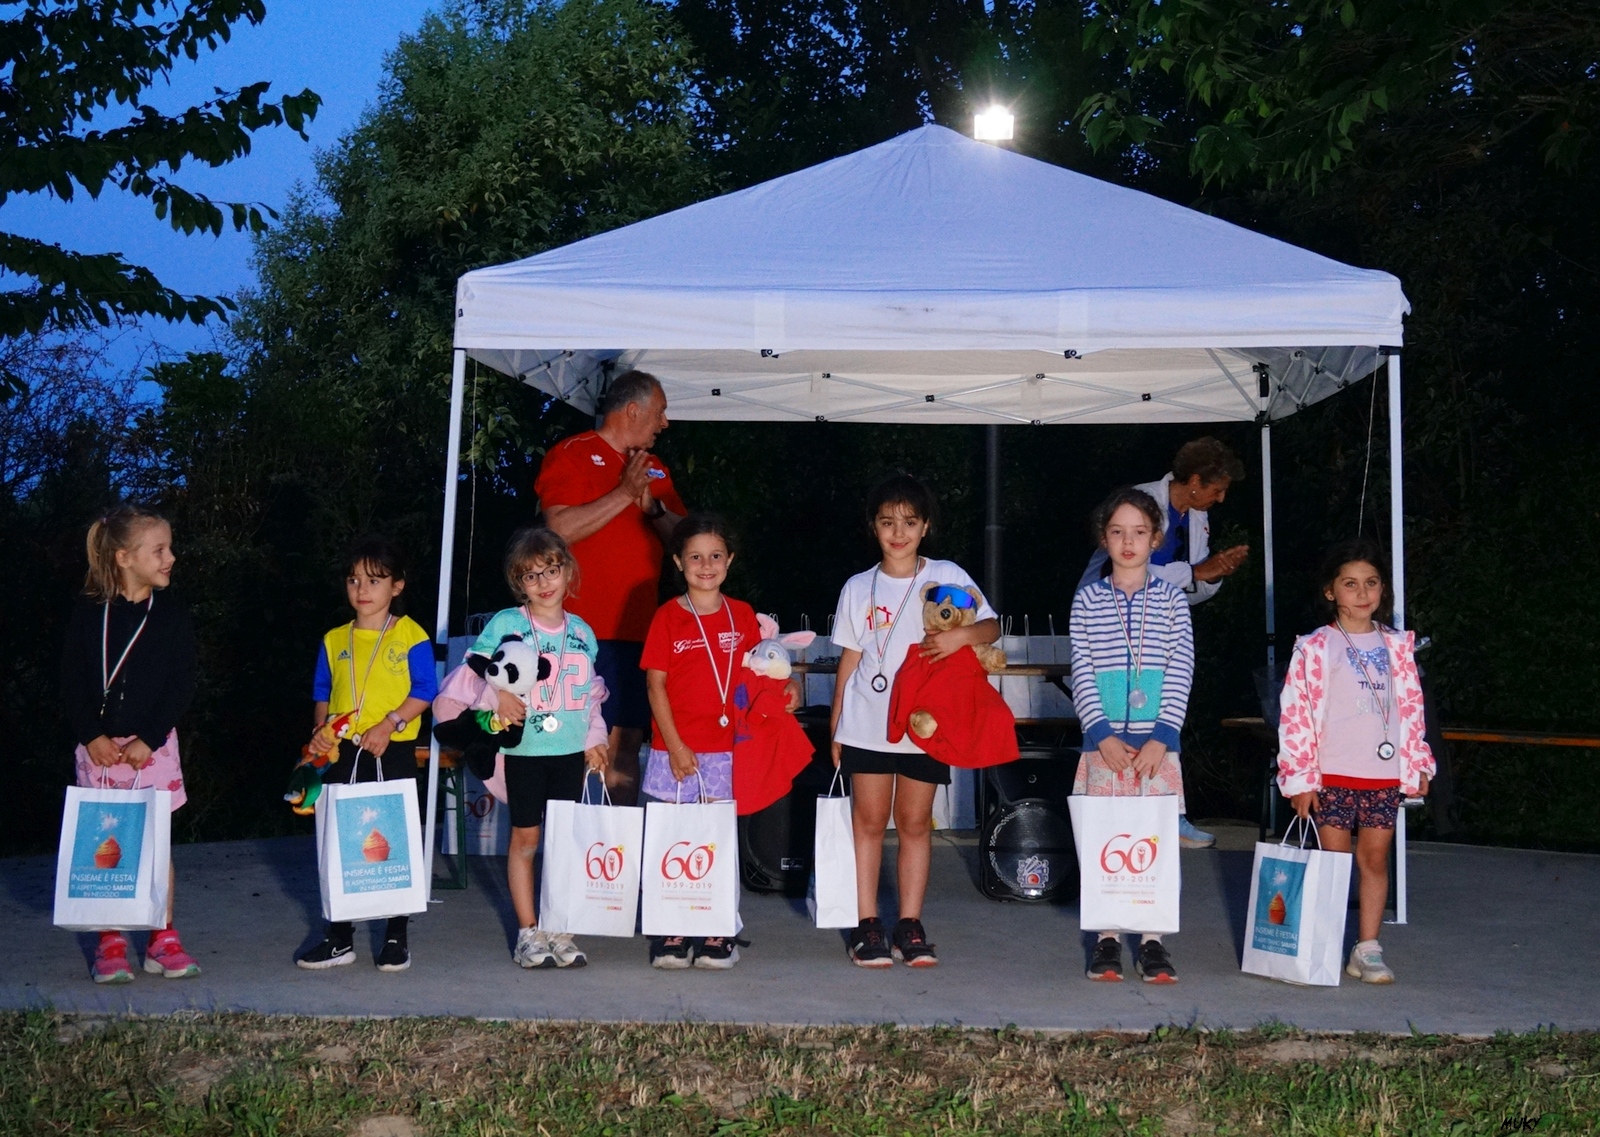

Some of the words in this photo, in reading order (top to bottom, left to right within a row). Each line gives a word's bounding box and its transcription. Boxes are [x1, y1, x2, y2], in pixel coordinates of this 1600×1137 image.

[1100, 834, 1157, 874] 60
[586, 842, 623, 881] 60
[661, 841, 714, 881] 60
[344, 868, 376, 877] INSIEME
[384, 864, 409, 874] FESTA!
[71, 873, 102, 882] INSIEME
[111, 874, 136, 882] FESTA!
[1101, 875, 1156, 883] 1959-2019
[586, 881, 624, 890] 1959-2019
[661, 881, 712, 889] 1959-2019
